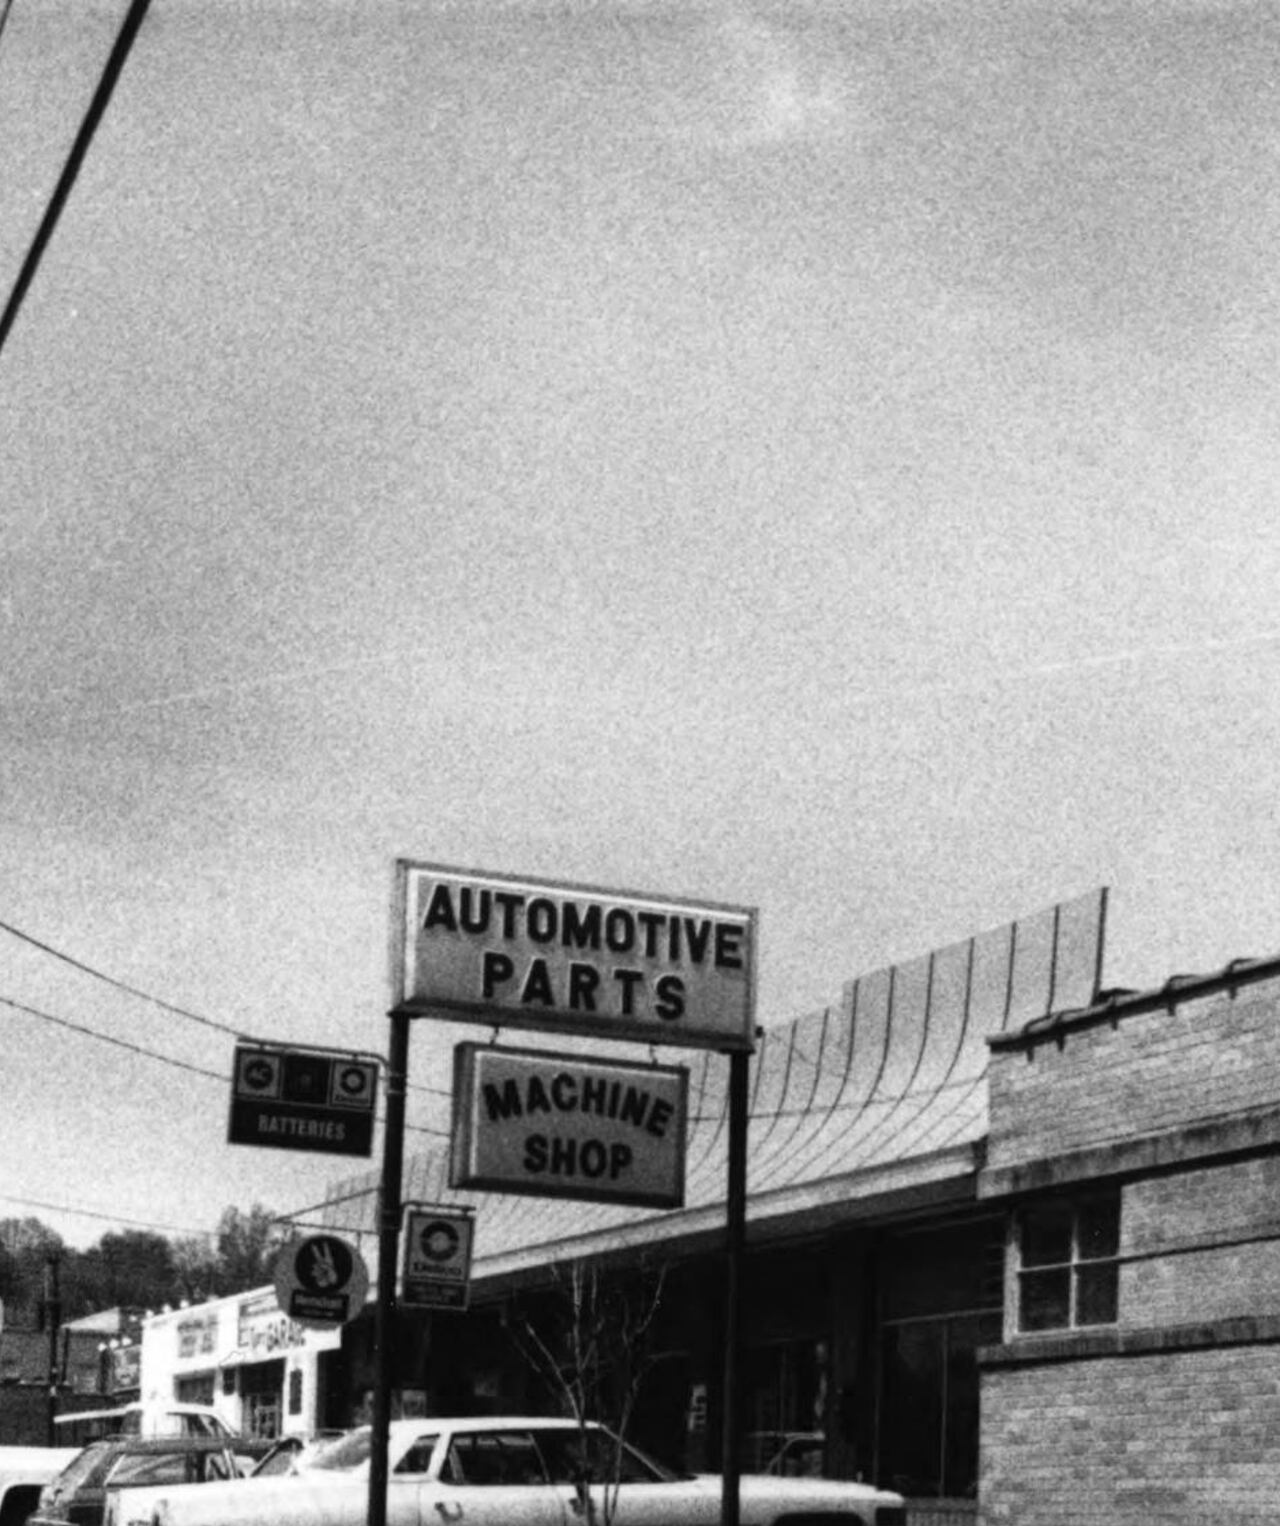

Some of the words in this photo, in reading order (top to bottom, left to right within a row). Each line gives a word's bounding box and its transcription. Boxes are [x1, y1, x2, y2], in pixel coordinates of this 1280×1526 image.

[423, 884, 744, 969] AUTOMOTIVE
[482, 951, 686, 1021] PARTS
[258, 1115, 345, 1140] BATTERIES
[483, 1073, 675, 1138] MACHINE
[523, 1134, 632, 1181] SHOP
